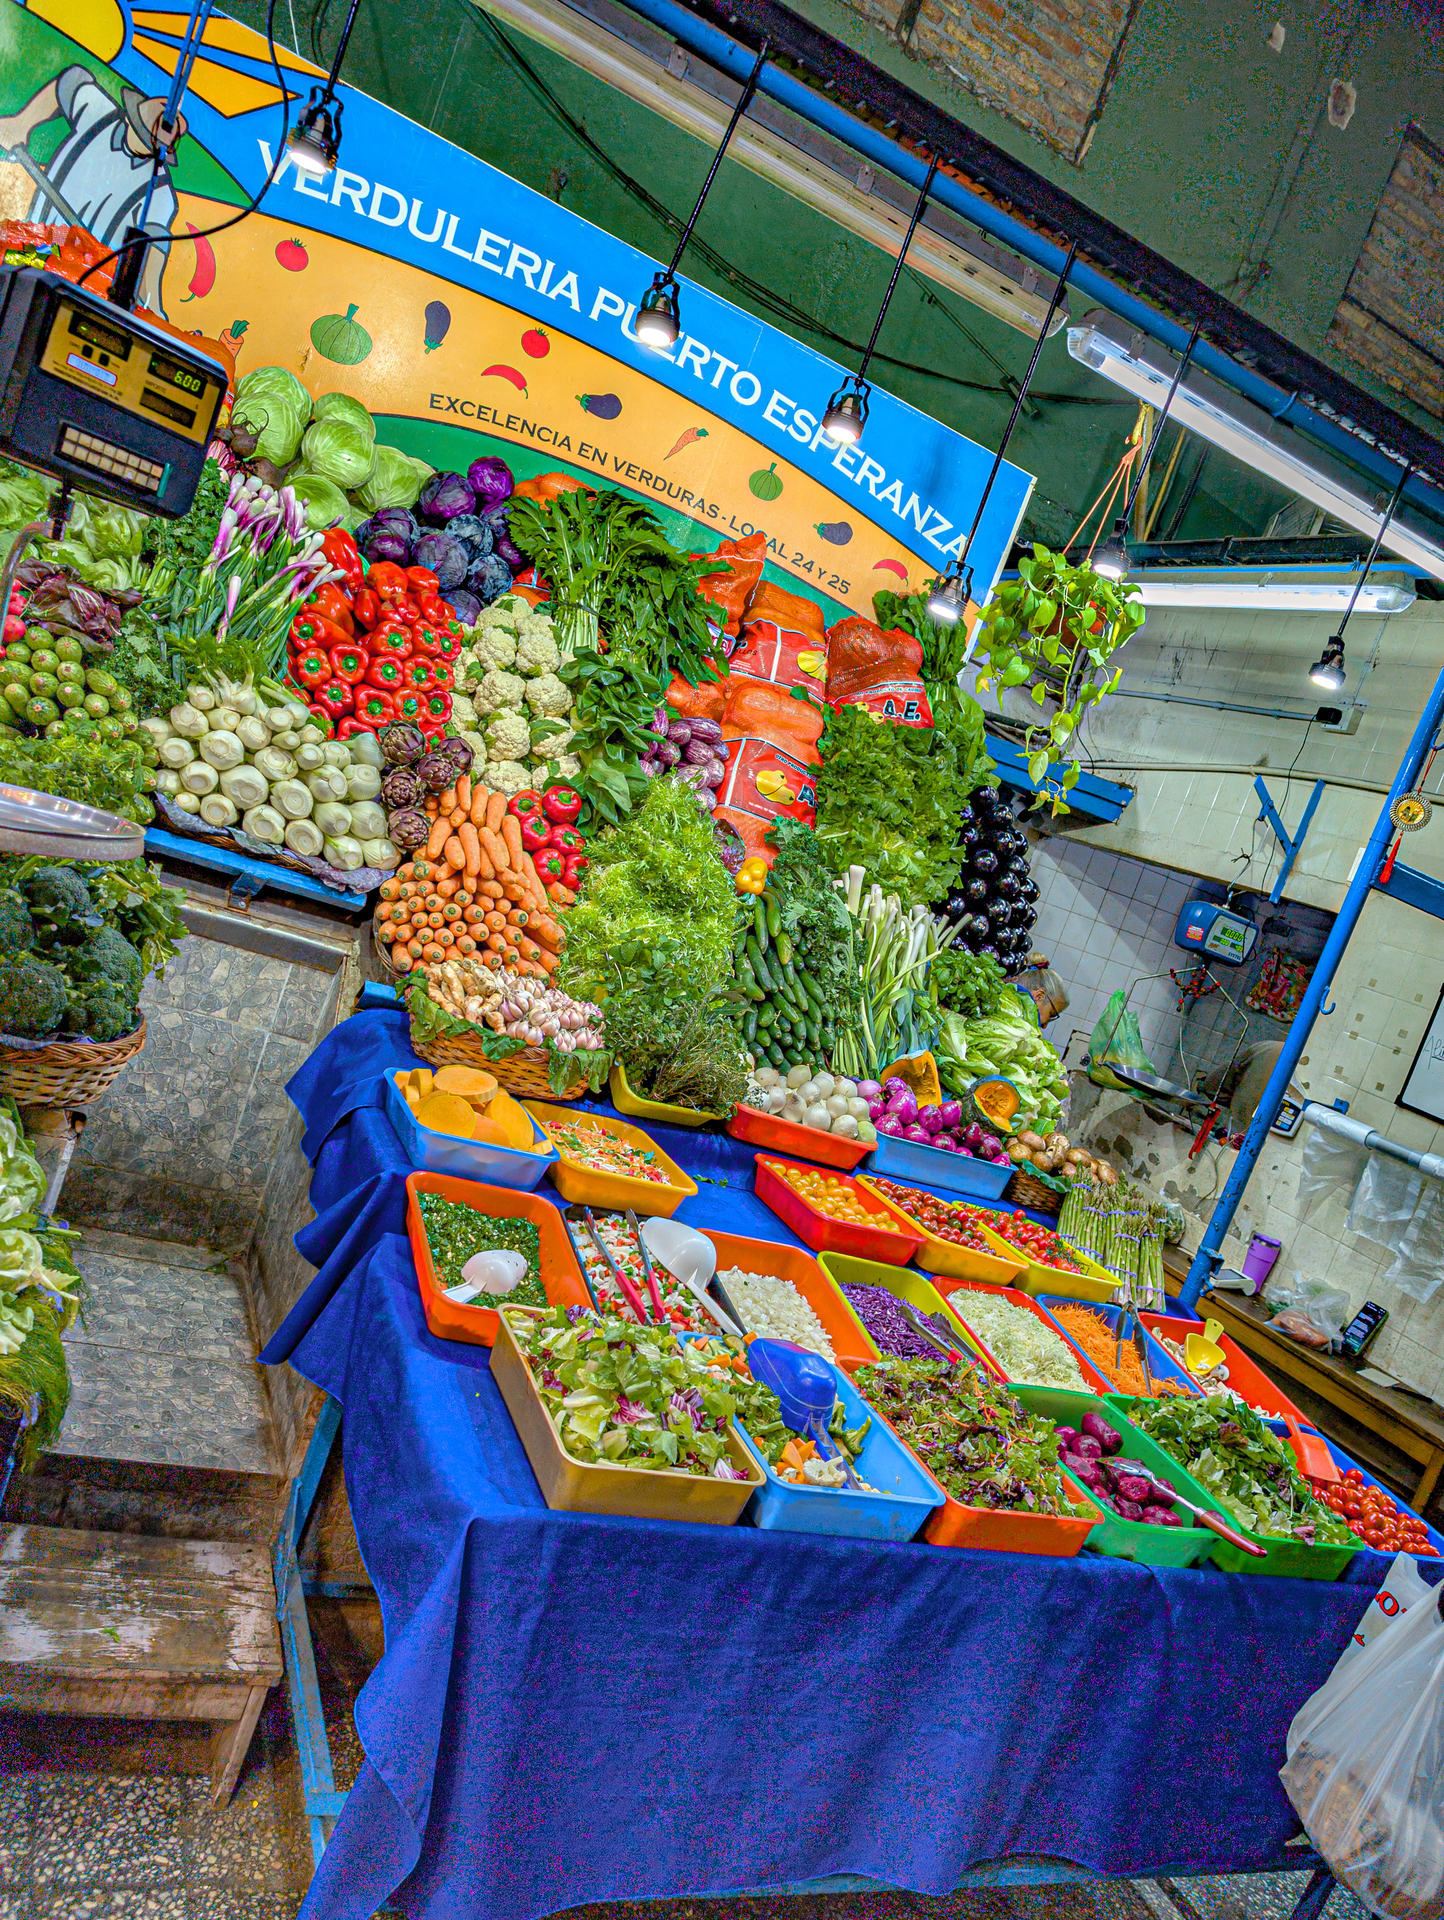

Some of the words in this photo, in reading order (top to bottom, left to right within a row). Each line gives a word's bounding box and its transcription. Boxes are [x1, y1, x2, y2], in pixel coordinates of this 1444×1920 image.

[257, 138, 582, 314] VERDULERIA
[429, 392, 572, 452] EXCELENCIA
[577, 441, 609, 466] EN
[613, 455, 721, 519] VERDURAS
[790, 552, 815, 574] 24
[817, 567, 828, 580] Y
[827, 574, 852, 595] 25
